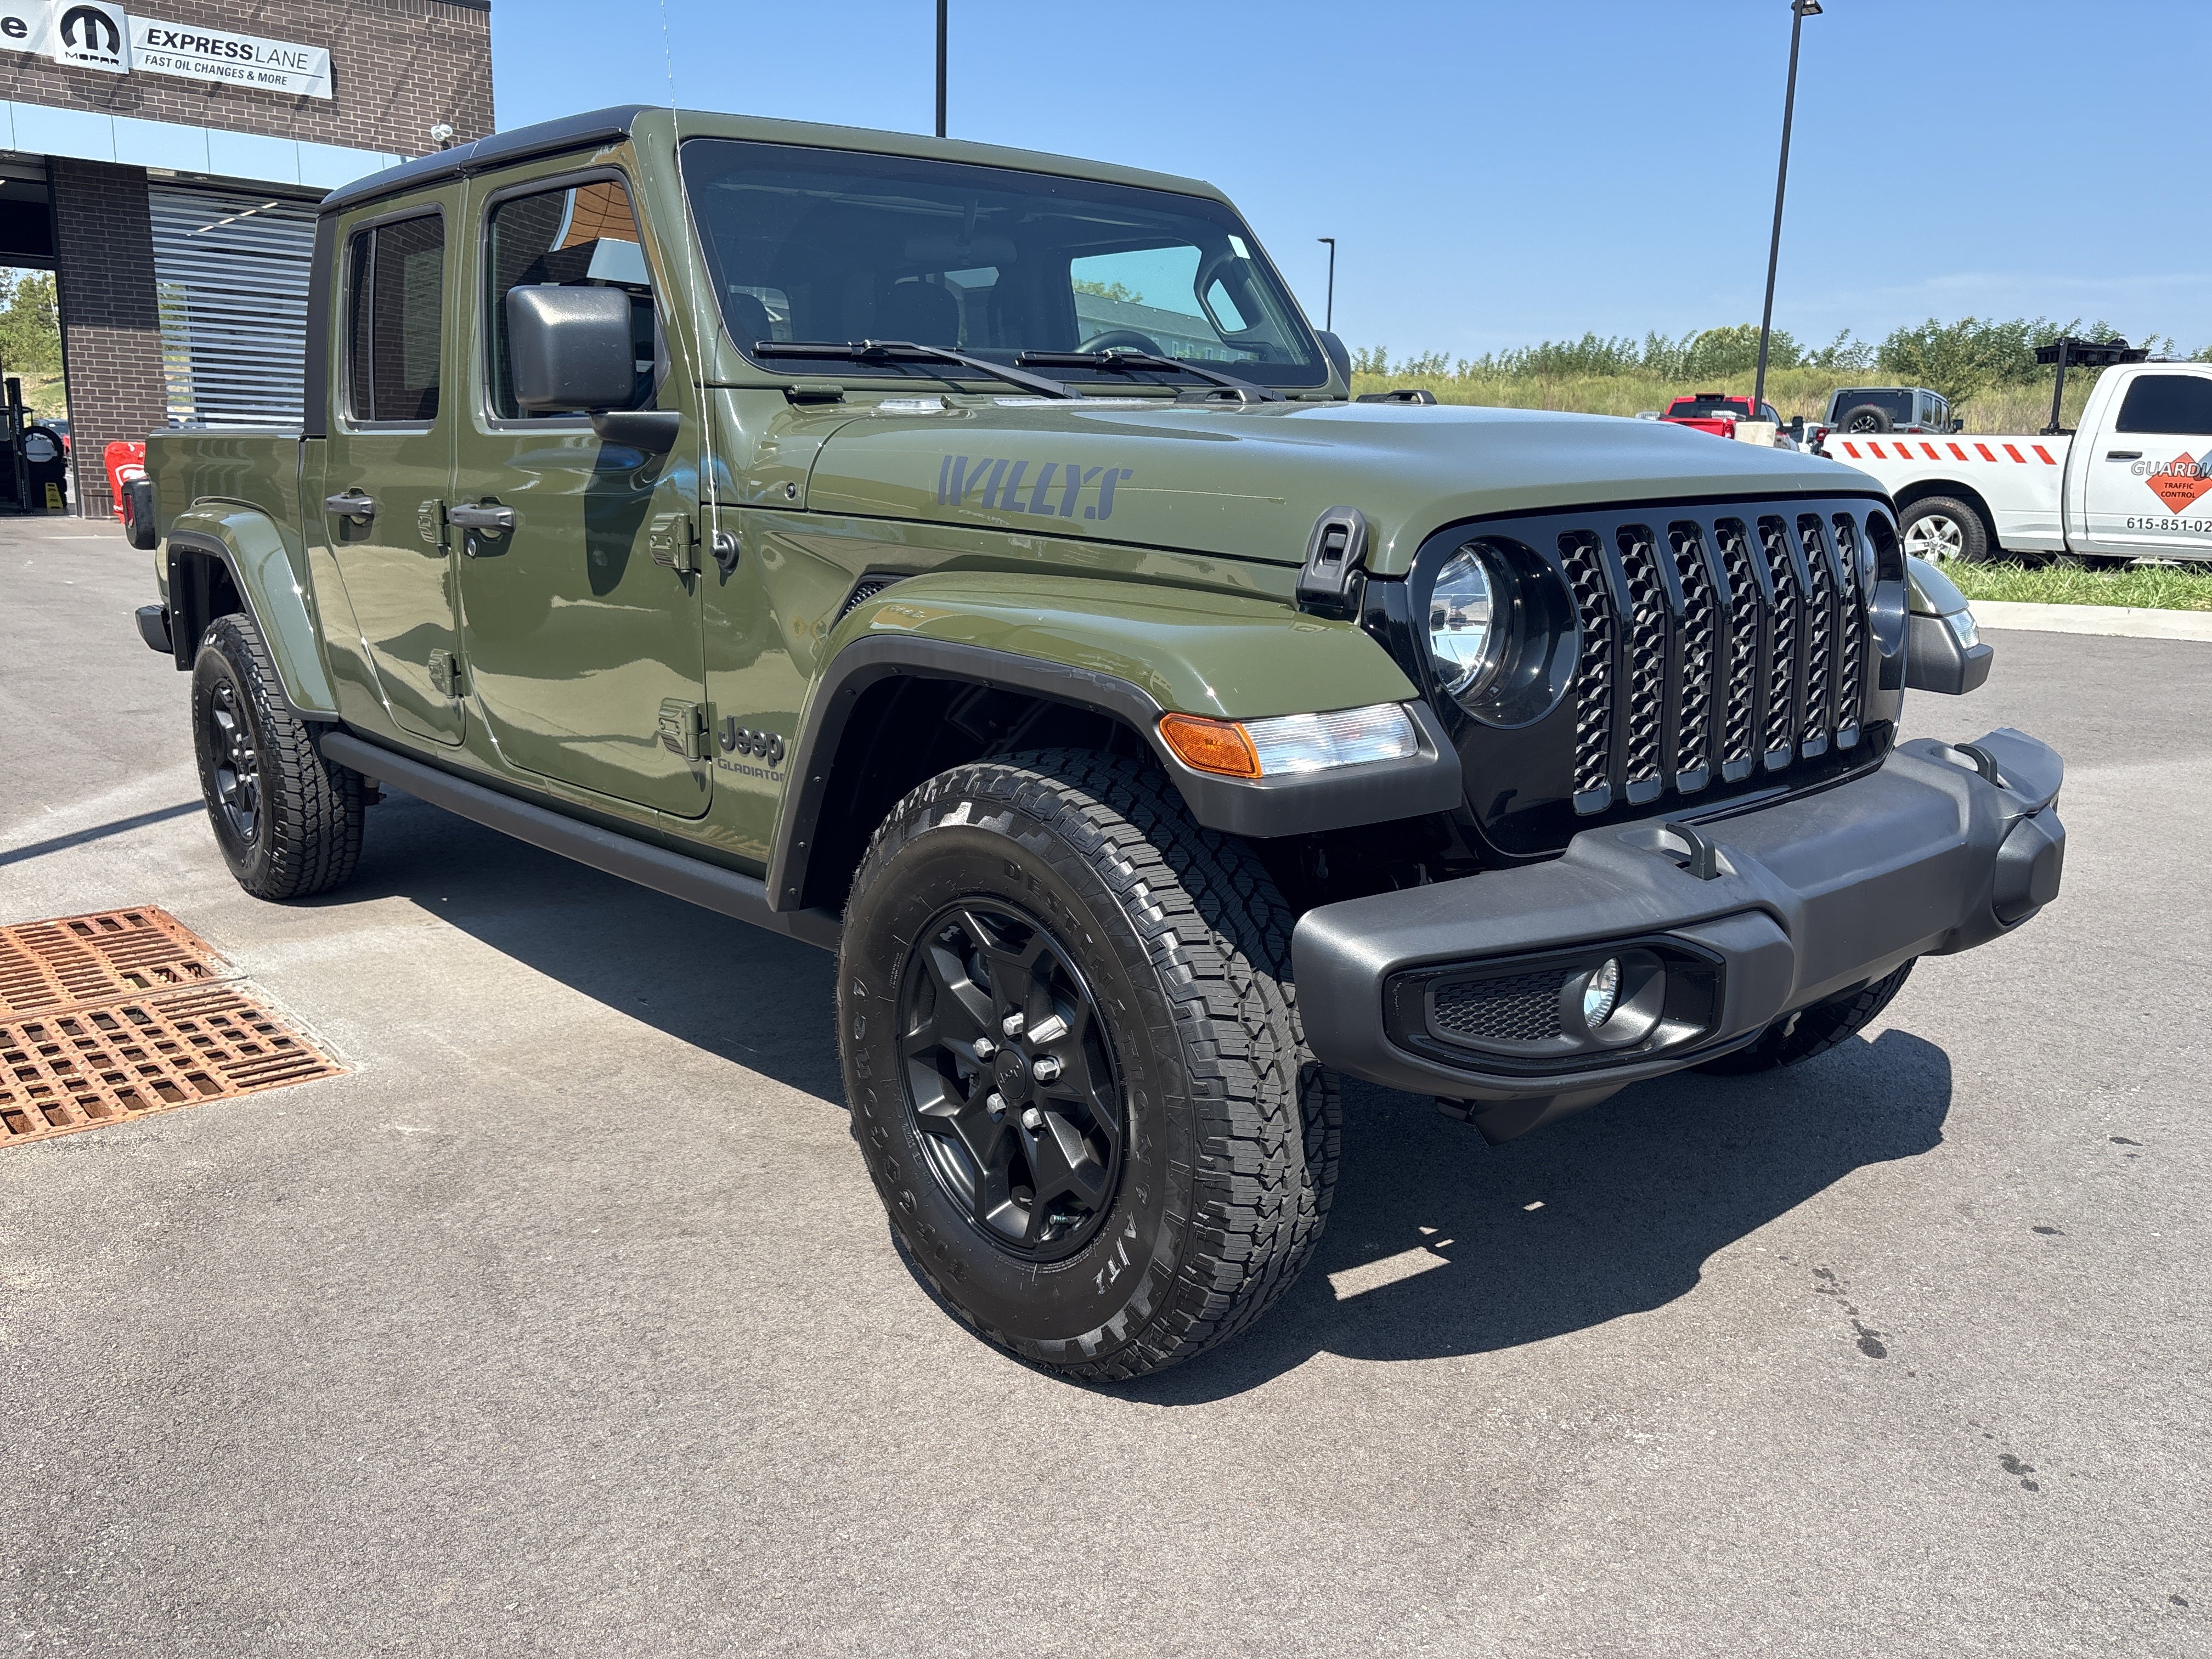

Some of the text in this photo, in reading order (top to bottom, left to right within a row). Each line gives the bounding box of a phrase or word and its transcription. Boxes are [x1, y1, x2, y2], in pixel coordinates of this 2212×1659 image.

[145, 55, 288, 86] FAST OIL CHANGES & MORE
[938, 455, 1134, 521] WILLYS
[2127, 517, 2212, 533] 615-851-02
[718, 715, 785, 768] Jeep
